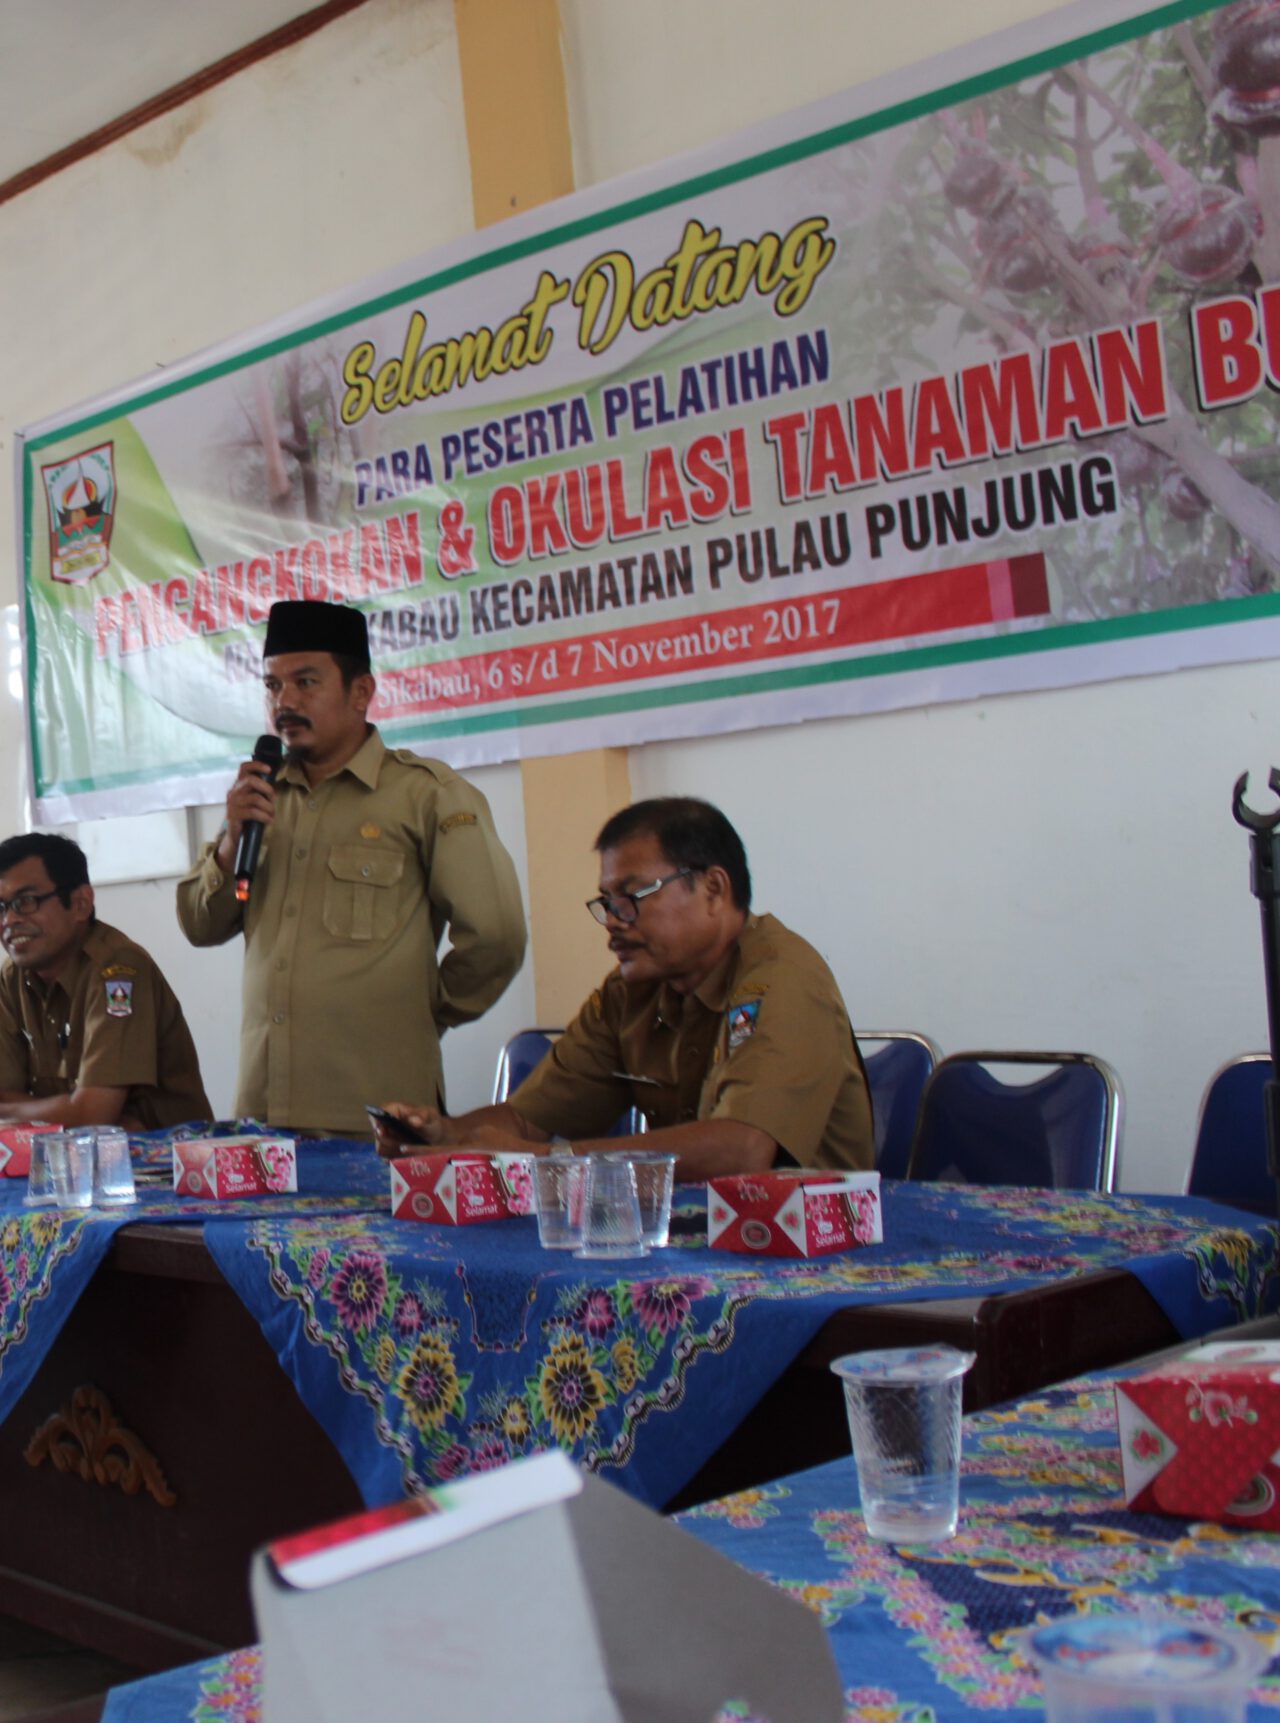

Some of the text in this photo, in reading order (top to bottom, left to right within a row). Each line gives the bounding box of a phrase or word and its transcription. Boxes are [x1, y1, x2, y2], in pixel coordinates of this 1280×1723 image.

[340, 216, 836, 425] Selamat Datang
[355, 330, 830, 506] PARA PESERTA PELATIHAN
[438, 501, 477, 579] &
[489, 428, 751, 566] OKULASI
[767, 320, 1167, 502] TANAMAN
[470, 546, 694, 635] KECAMATAN
[708, 512, 851, 590] PULAU
[866, 457, 1117, 558] PUNJUNG
[377, 600, 841, 708] Sikabau, 6 s/d 7 November 2017
[465, 1203, 498, 1218] Selamat
